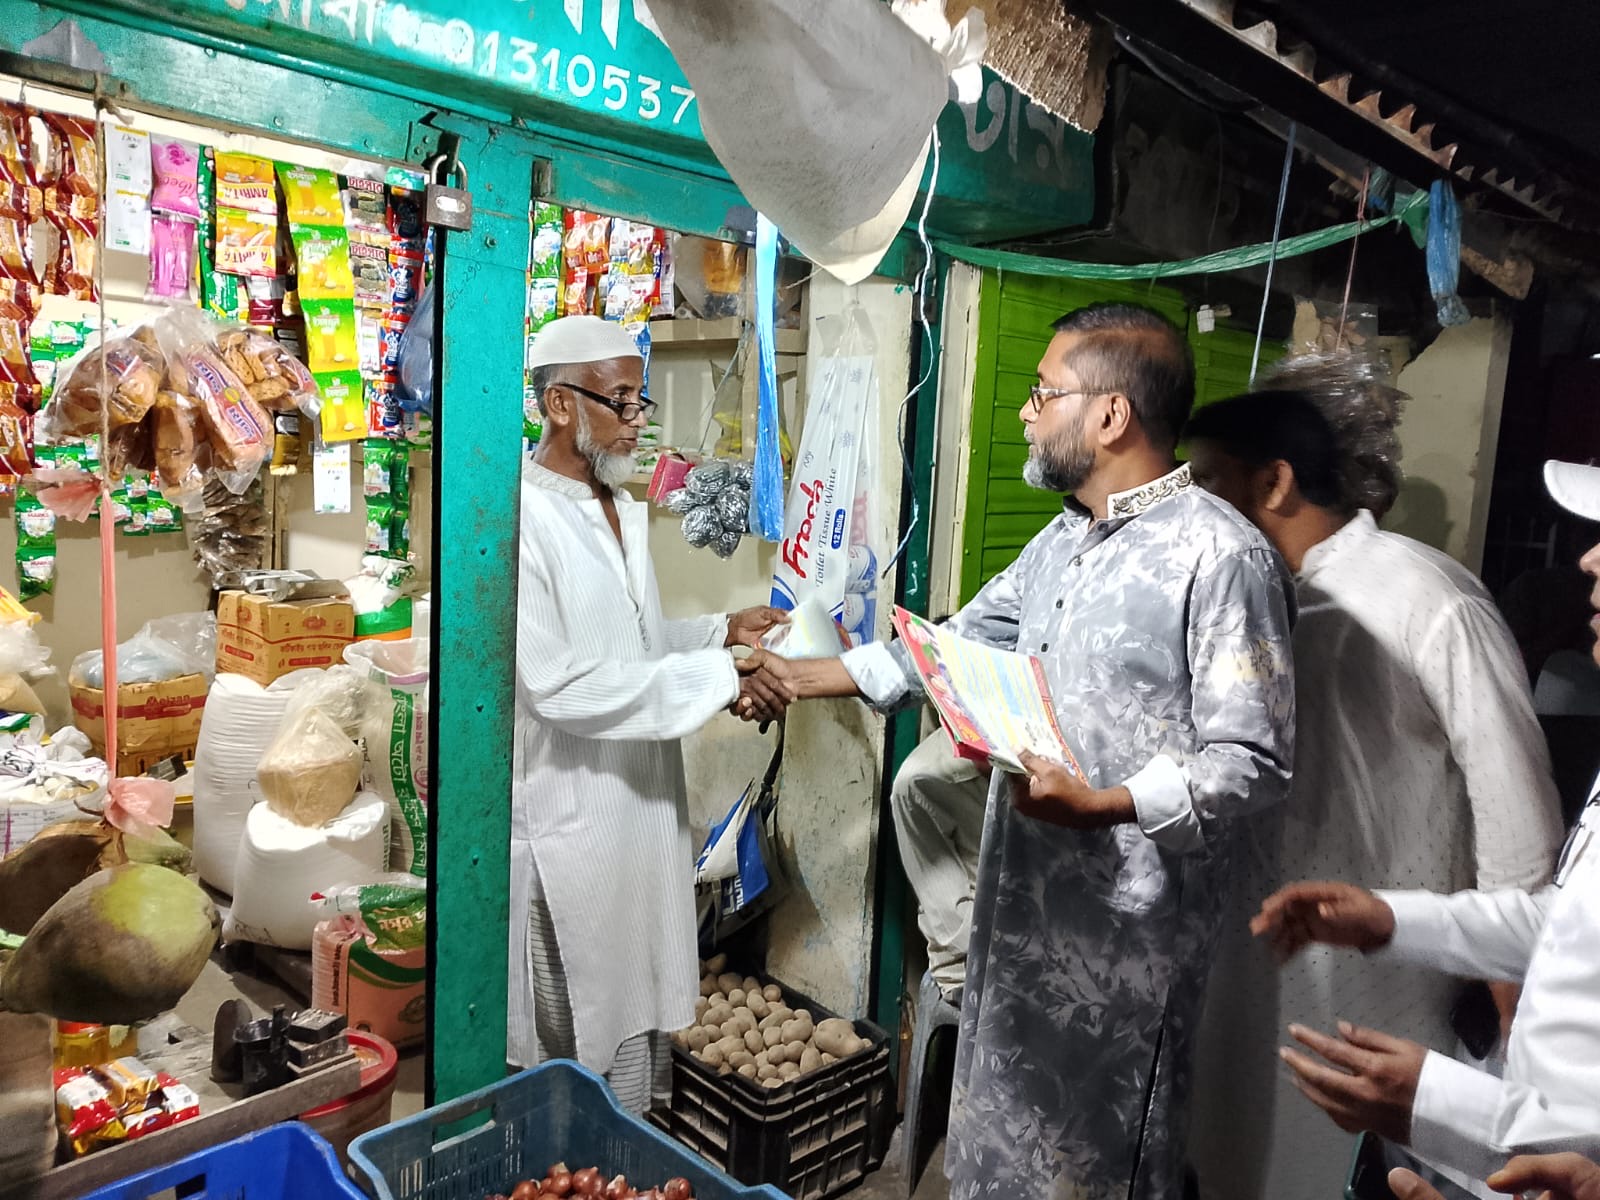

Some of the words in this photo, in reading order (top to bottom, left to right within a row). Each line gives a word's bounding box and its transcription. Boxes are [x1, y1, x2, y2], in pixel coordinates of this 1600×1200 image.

[823, 467, 837, 507] White
[817, 509, 831, 549] Tissue
[833, 533, 840, 546] 12
[814, 551, 825, 587] Toilet
[391, 739, 409, 784] অটো
